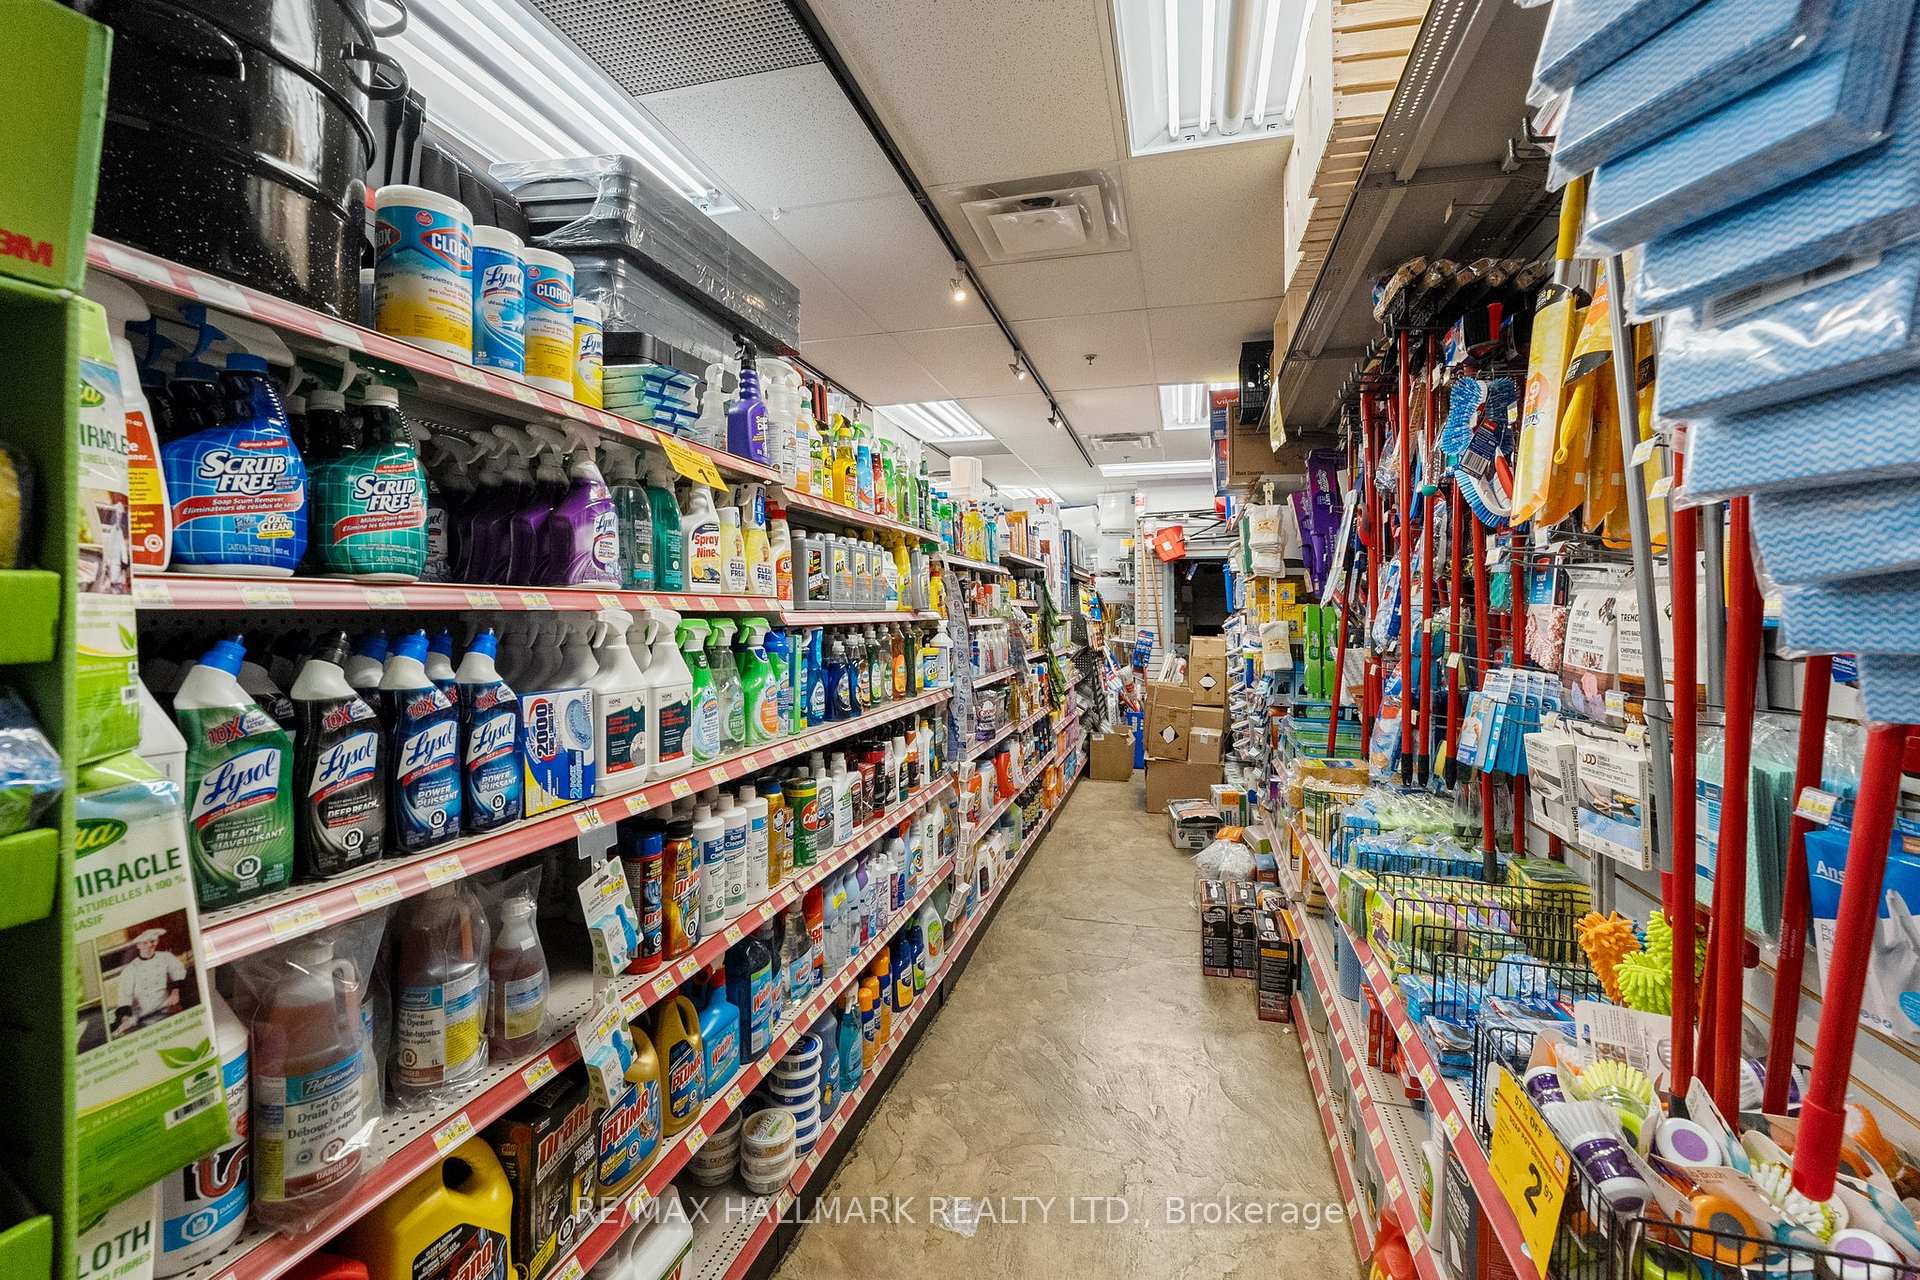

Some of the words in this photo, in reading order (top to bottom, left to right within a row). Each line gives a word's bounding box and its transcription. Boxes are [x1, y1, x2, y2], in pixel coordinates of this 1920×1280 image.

[431, 232, 473, 268] CLORO
[485, 265, 524, 289] Lysol
[79, 424, 128, 456] IRACLE
[199, 448, 287, 479] SCRUB
[216, 473, 275, 495] FREE
[353, 474, 417, 499] SCRUB
[368, 493, 410, 513] FREE
[694, 534, 720, 550] Spray
[696, 546, 717, 559] Nine
[729, 562, 745, 570] CLEA
[730, 570, 745, 578] FREA
[756, 566, 773, 575] CLEA
[473, 713, 513, 753] Lysol
[535, 703, 549, 758] 2000
[406, 722, 456, 766] Lysol
[319, 735, 374, 783] Lysol
[203, 750, 275, 805] Lysol
[481, 770, 512, 784] POWER
[417, 784, 451, 800] POWER
[1816, 860, 1846, 881] Ans
[76, 887, 142, 917] ATURELLES
[297, 1108, 329, 1124] Drain
[1524, 1161, 1543, 1217] 2
[77, 1220, 151, 1279] LOTH
